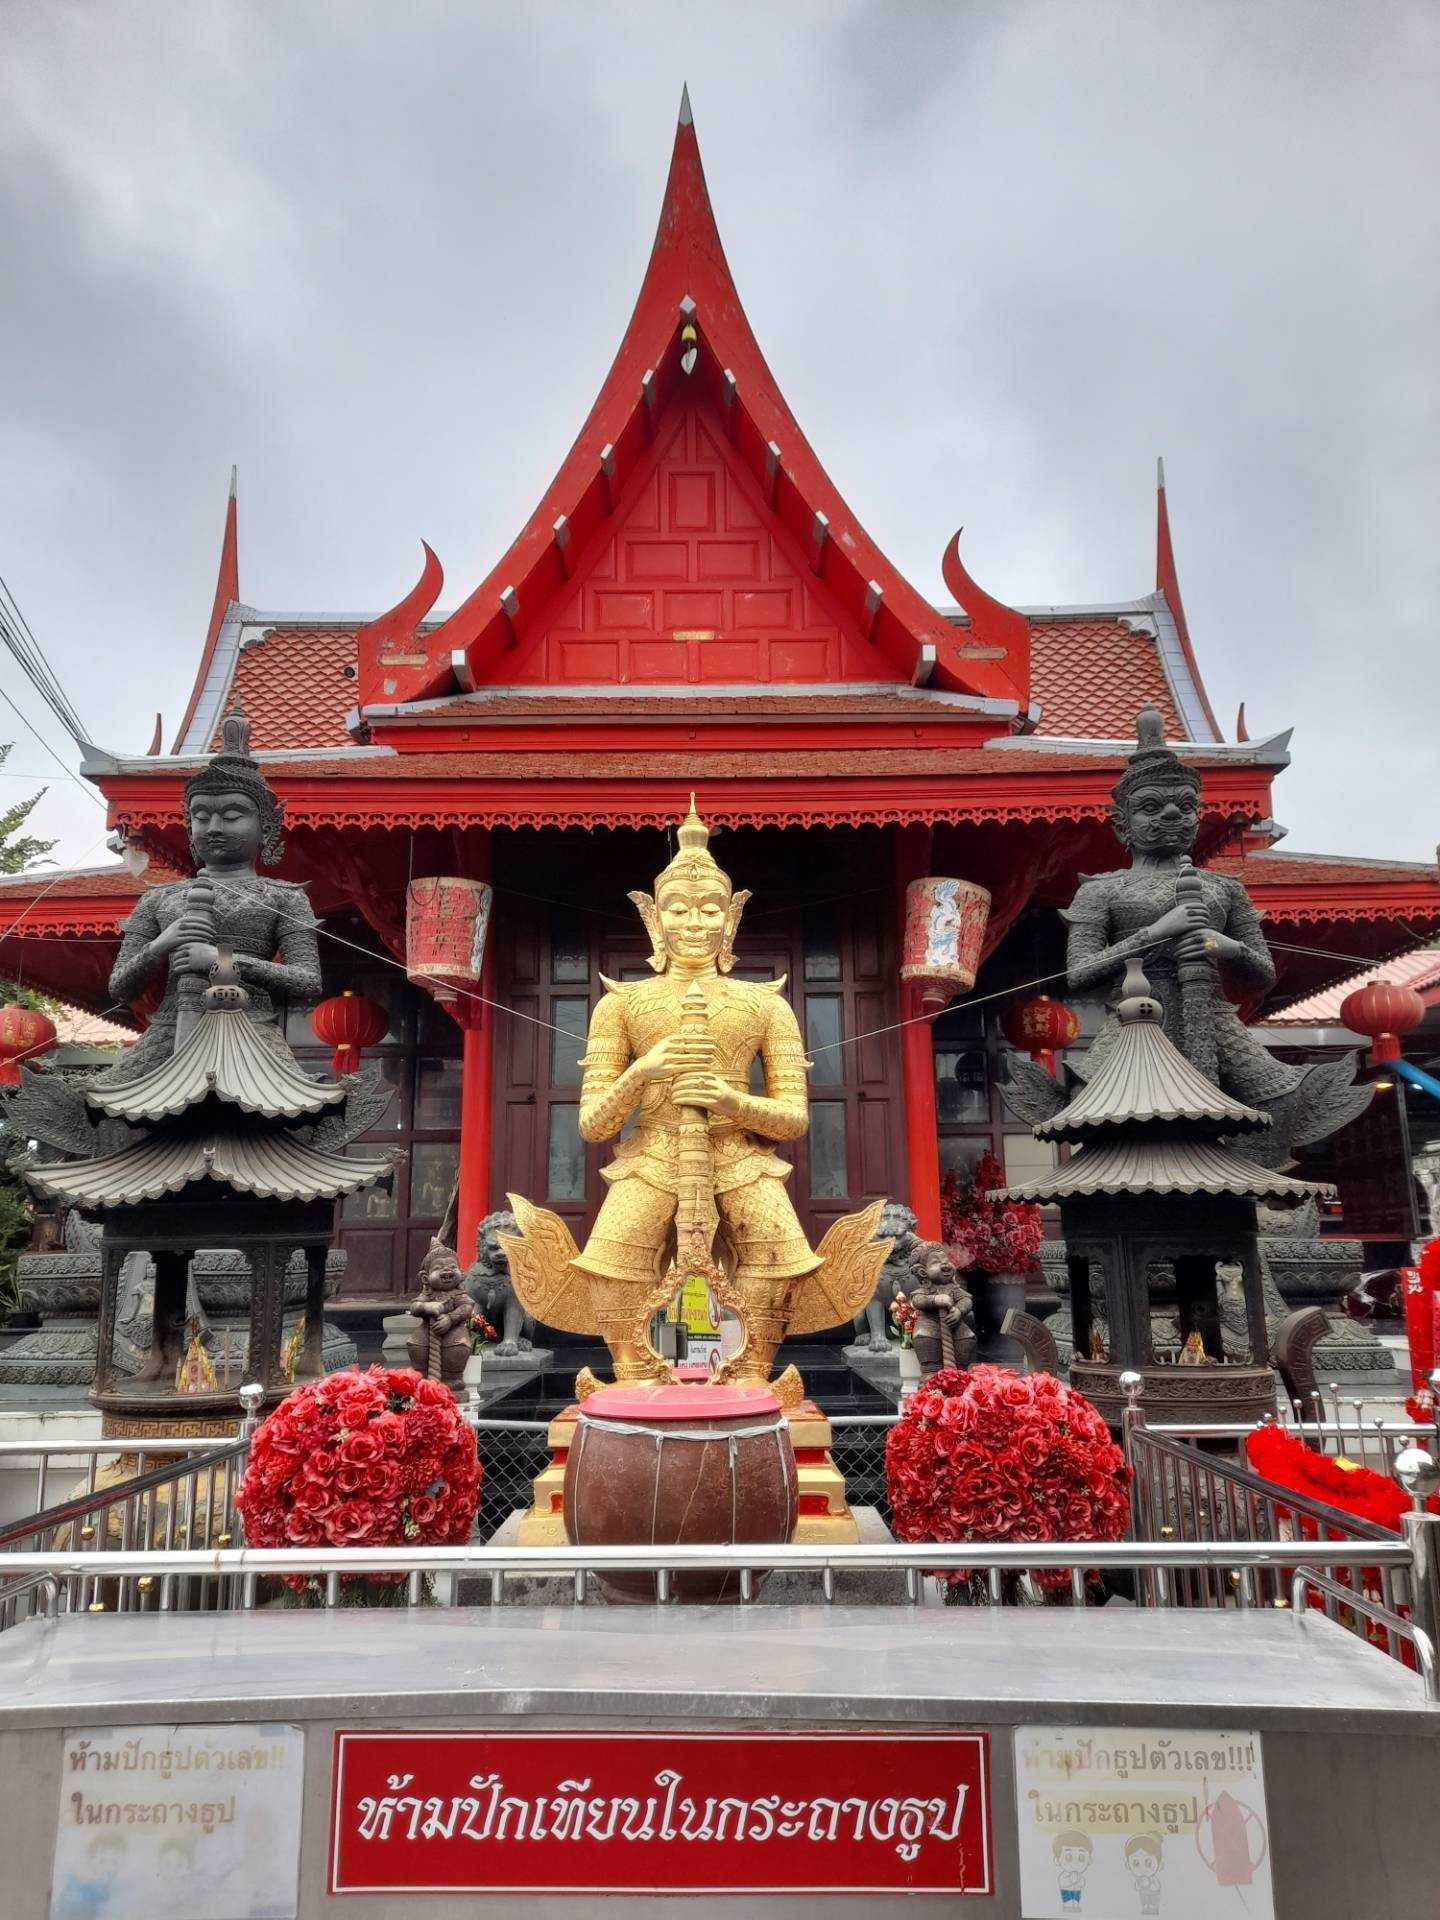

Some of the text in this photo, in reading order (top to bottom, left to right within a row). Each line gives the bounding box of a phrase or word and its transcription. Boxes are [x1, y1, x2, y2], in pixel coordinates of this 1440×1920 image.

[70, 1791, 237, 1834] ในกระถางธูป
[356, 1768, 970, 1862] ห้ามปักเทียนในกระถางธูป
[1028, 1788, 1199, 1834] ในกระถางธูป
